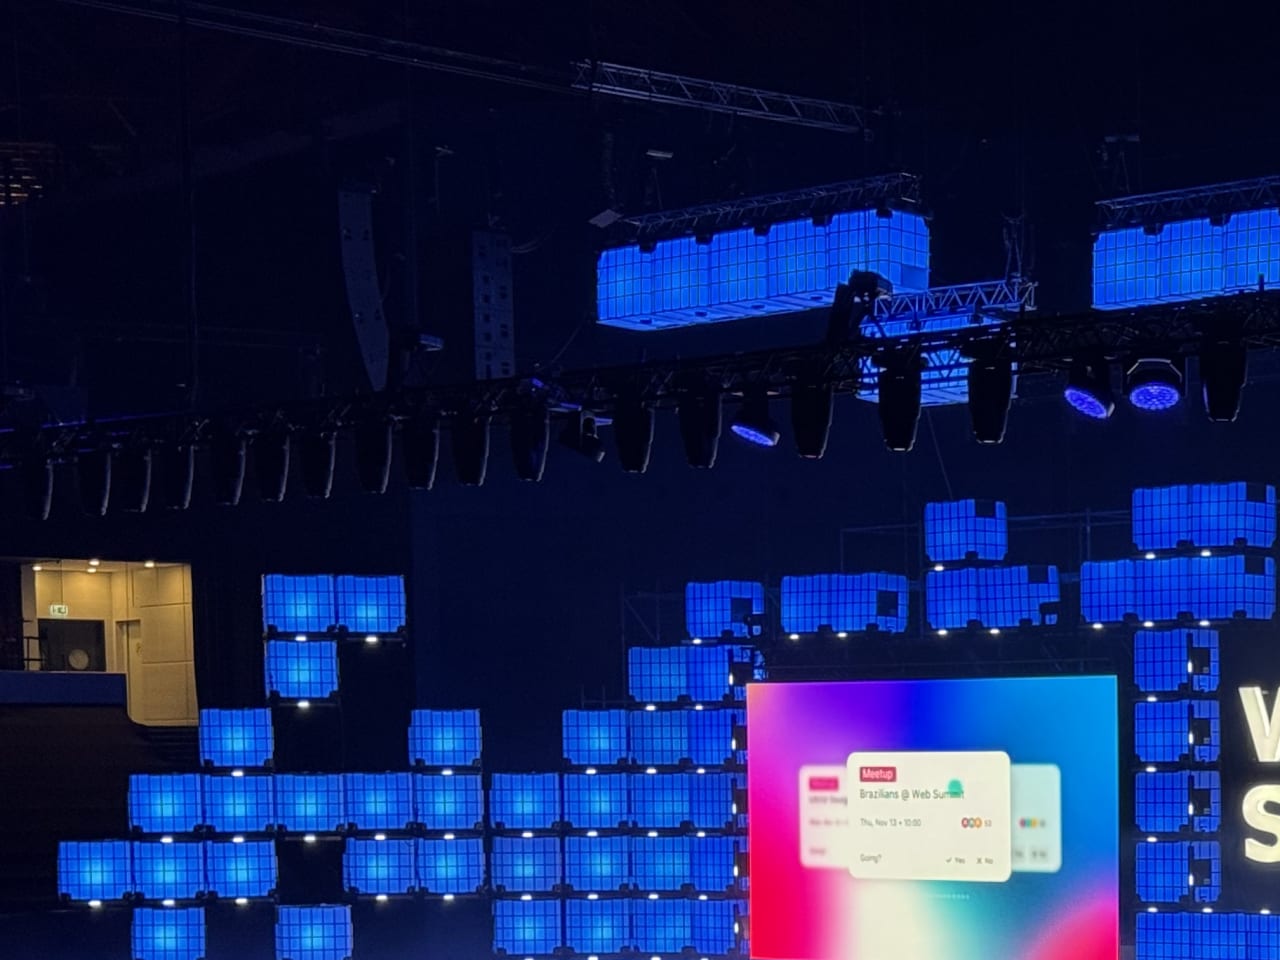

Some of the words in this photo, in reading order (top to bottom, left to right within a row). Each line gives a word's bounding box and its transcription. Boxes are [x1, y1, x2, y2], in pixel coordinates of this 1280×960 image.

[862, 768, 893, 780] Meetup
[860, 788, 899, 799] Brazilians
[912, 789, 931, 799] Web
